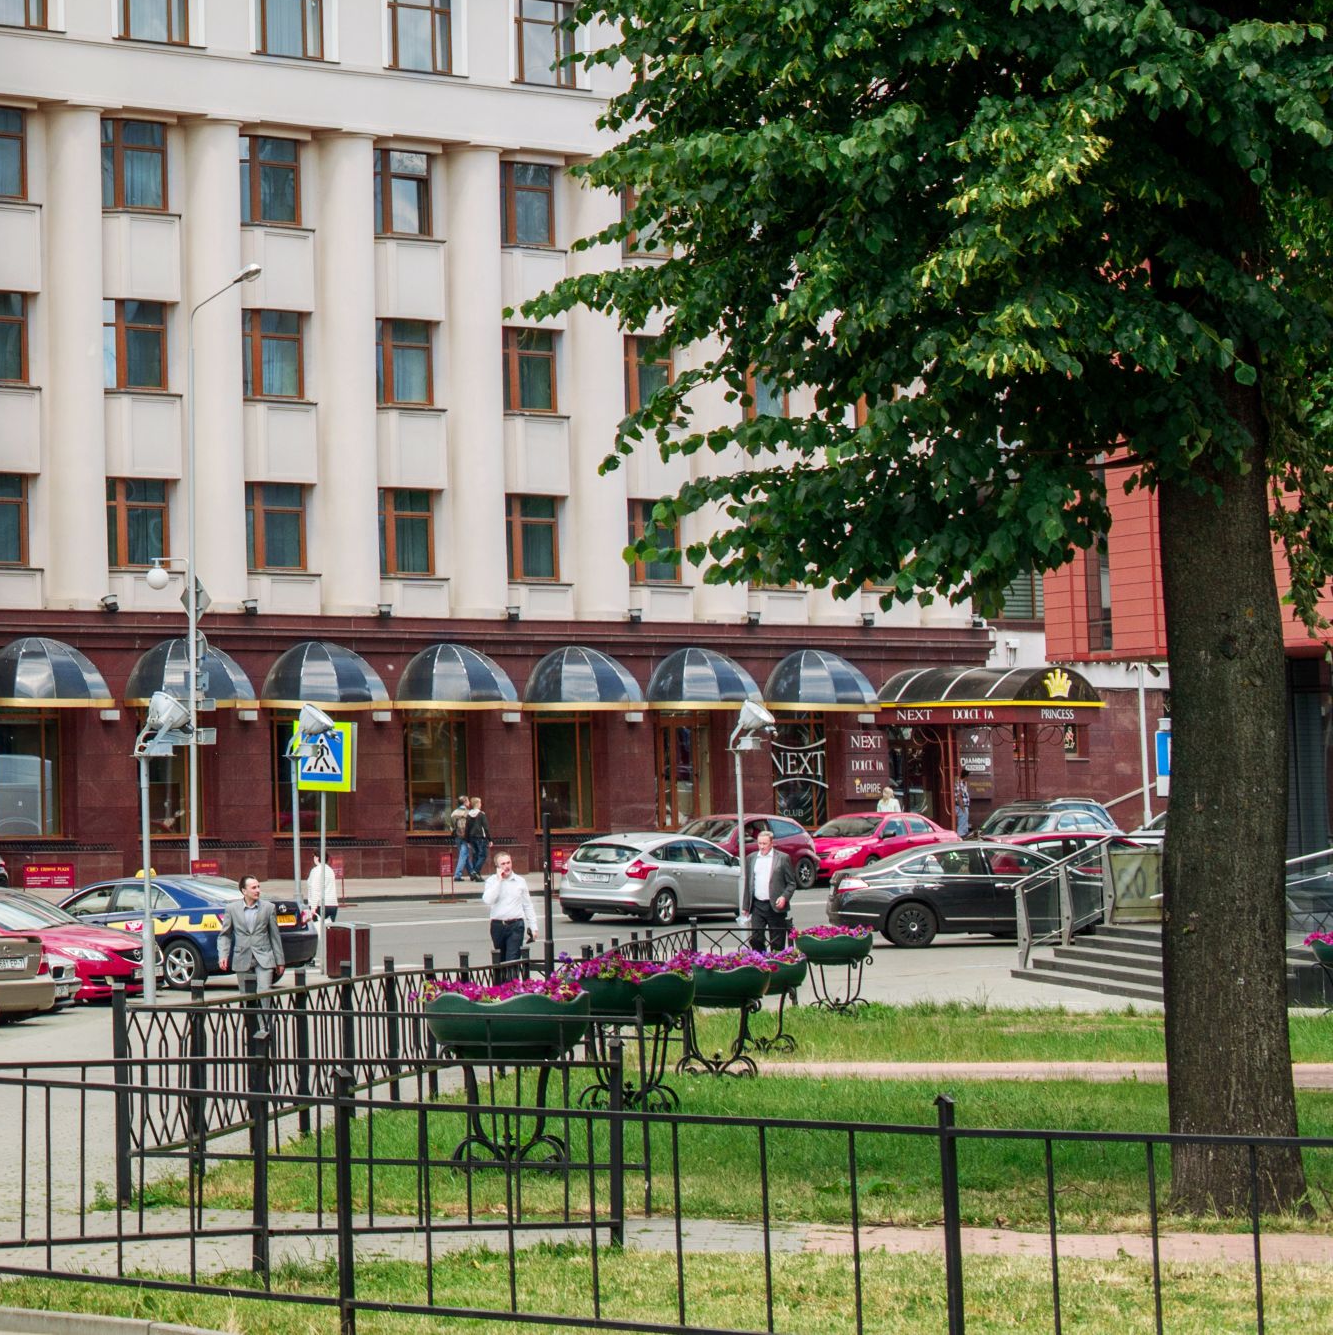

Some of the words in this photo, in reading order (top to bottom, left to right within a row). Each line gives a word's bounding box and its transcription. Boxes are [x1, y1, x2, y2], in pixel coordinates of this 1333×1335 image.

[896, 709, 933, 721] NEXT
[952, 708, 979, 720] DOLCE
[1040, 708, 1074, 720] PRINCESS
[850, 735, 883, 749] NEXT
[771, 750, 826, 776] NEXT
[855, 783, 882, 794] EMPIRE
[783, 808, 804, 817] CLUB
